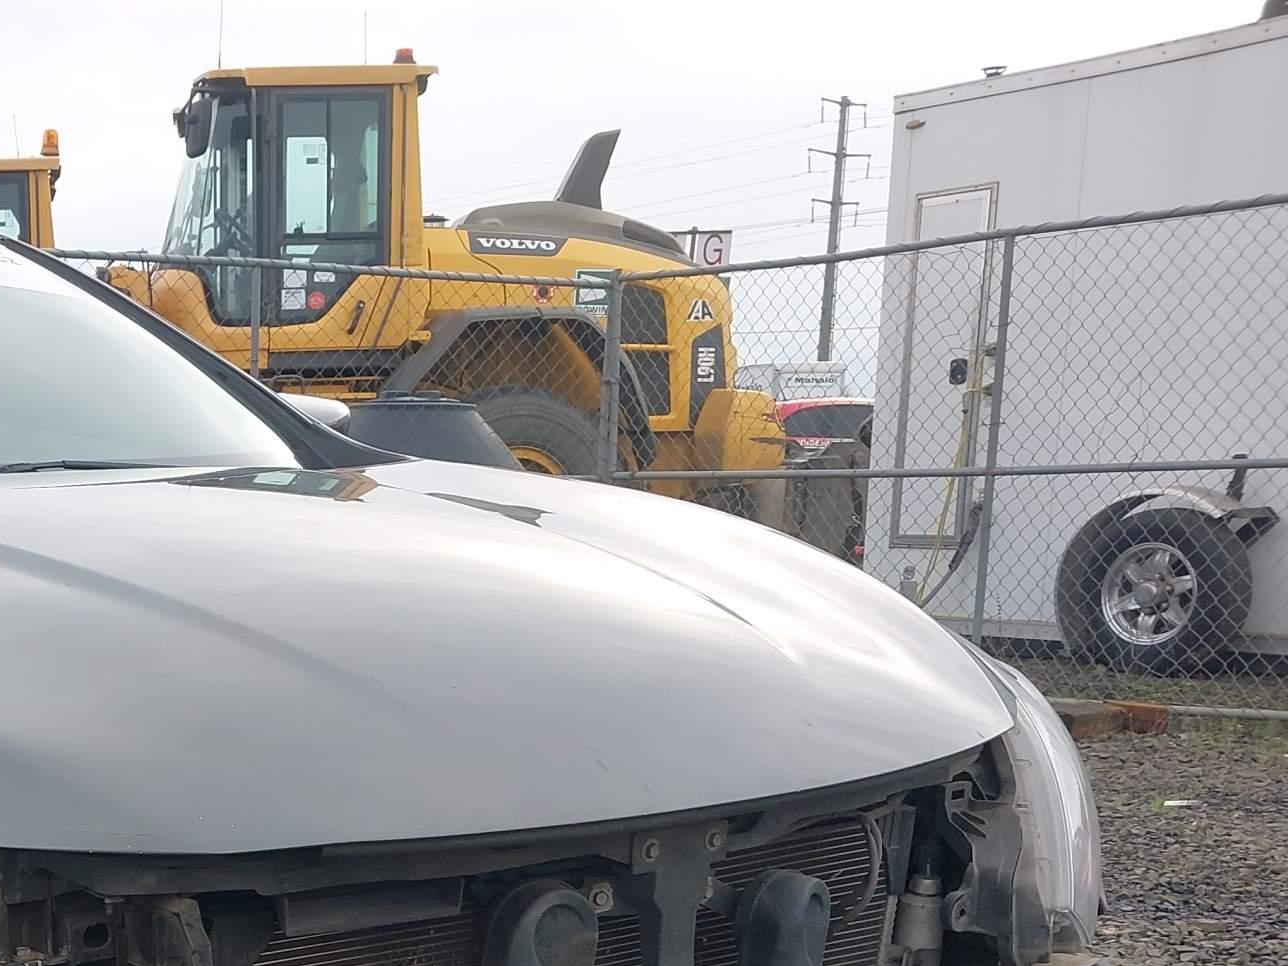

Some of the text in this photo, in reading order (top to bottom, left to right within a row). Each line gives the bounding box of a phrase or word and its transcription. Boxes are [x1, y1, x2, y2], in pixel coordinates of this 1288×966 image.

[476, 237, 556, 251] VOLVO
[703, 234, 724, 266] G
[696, 347, 717, 383] L90H
